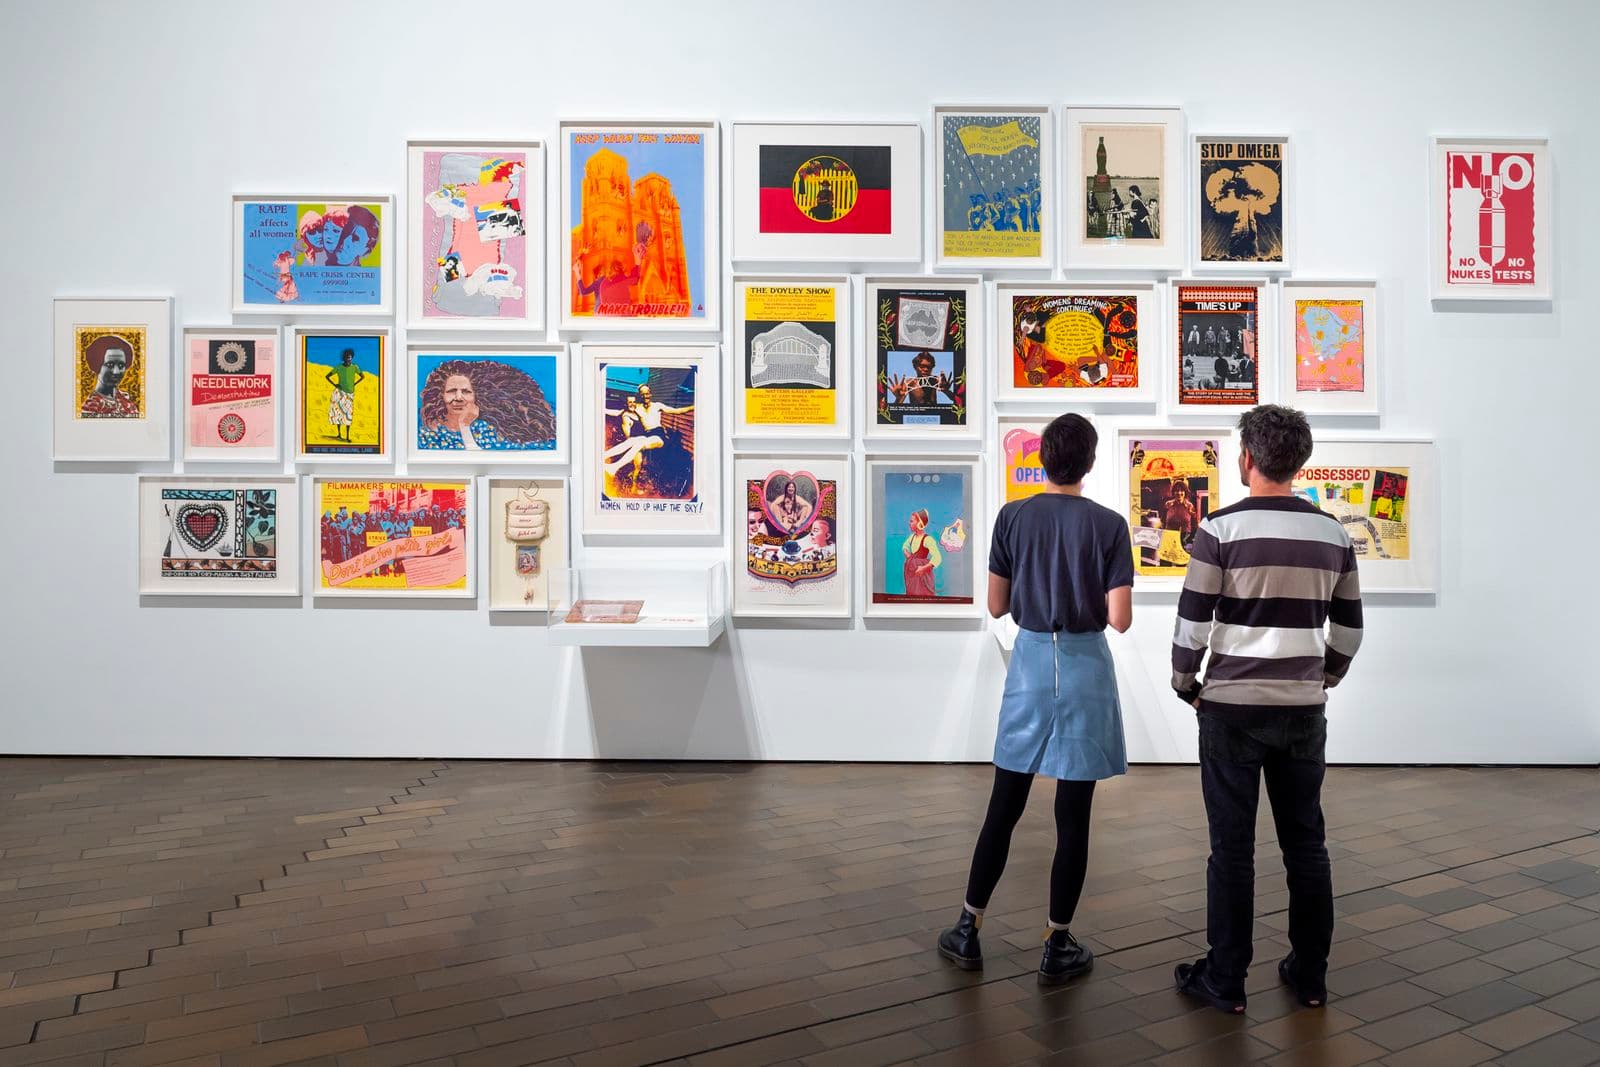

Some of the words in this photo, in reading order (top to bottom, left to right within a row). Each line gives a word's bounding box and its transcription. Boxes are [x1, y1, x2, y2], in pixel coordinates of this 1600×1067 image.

[1201, 143, 1223, 158] STOP
[1238, 143, 1280, 158] OMEGA
[259, 205, 287, 213] RAPE
[260, 219, 288, 227] affects
[250, 230, 260, 238] all
[1459, 258, 1476, 266] NO
[1508, 258, 1525, 267] NO
[1451, 270, 1491, 279] NUKES
[1495, 270, 1532, 279] TESTS
[1074, 298, 1107, 310] DREAMING
[1195, 302, 1226, 311] TIME'S
[1228, 302, 1242, 311] UP
[597, 304, 629, 315] MAKE
[1056, 305, 1093, 313] CONTINUES
[193, 378, 269, 388] NEEDLEWORK
[327, 482, 384, 490] FILMMAKERS
[390, 482, 424, 490] CINEMA
[600, 502, 621, 511] WOMEN
[626, 502, 640, 511] HOLD
[643, 503, 651, 511] UP
[653, 503, 667, 512] HALF
[670, 503, 681, 512] THE
